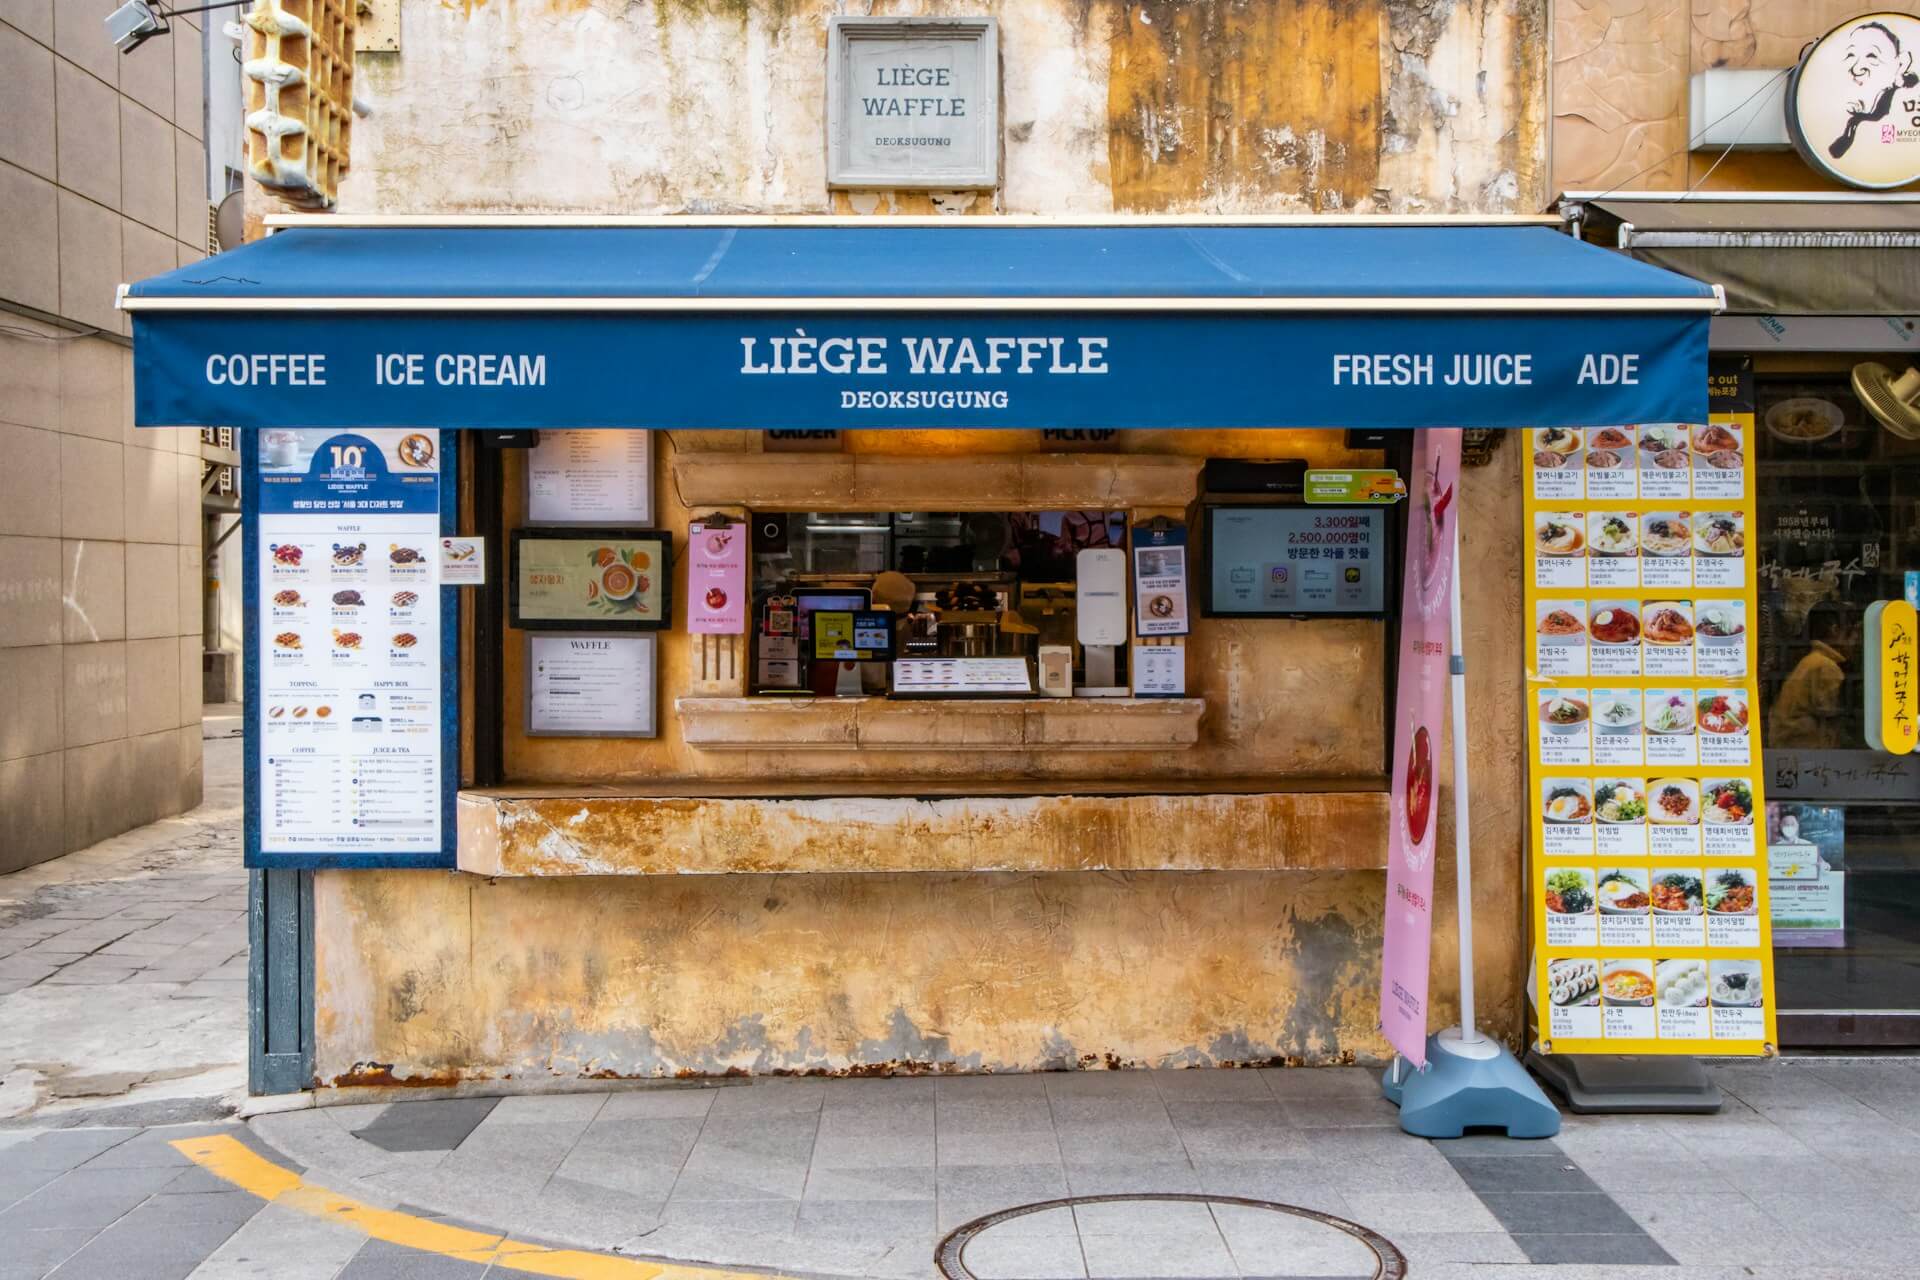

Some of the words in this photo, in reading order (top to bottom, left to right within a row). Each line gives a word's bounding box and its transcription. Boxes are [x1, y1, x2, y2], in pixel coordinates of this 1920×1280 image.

[877, 63, 951, 86] LIÈGE
[861, 98, 966, 117] WAFFLE
[875, 137, 951, 146] DEOKSUGUNG
[1896, 129, 1920, 137] MYEO
[740, 327, 888, 375] LIÈGE
[901, 337, 1109, 375] WAFFLE
[206, 354, 326, 386] COFFEE
[375, 353, 424, 385] ICE
[434, 354, 546, 386] CREAM
[1333, 354, 1434, 386] FRESH
[1443, 354, 1532, 386] JUICE
[1576, 354, 1639, 385] ADE
[840, 390, 1009, 409] DEOKSUGUNG
[570, 639, 611, 649] WAFFLE
[1598, 826, 1619, 835] 비빔밥
